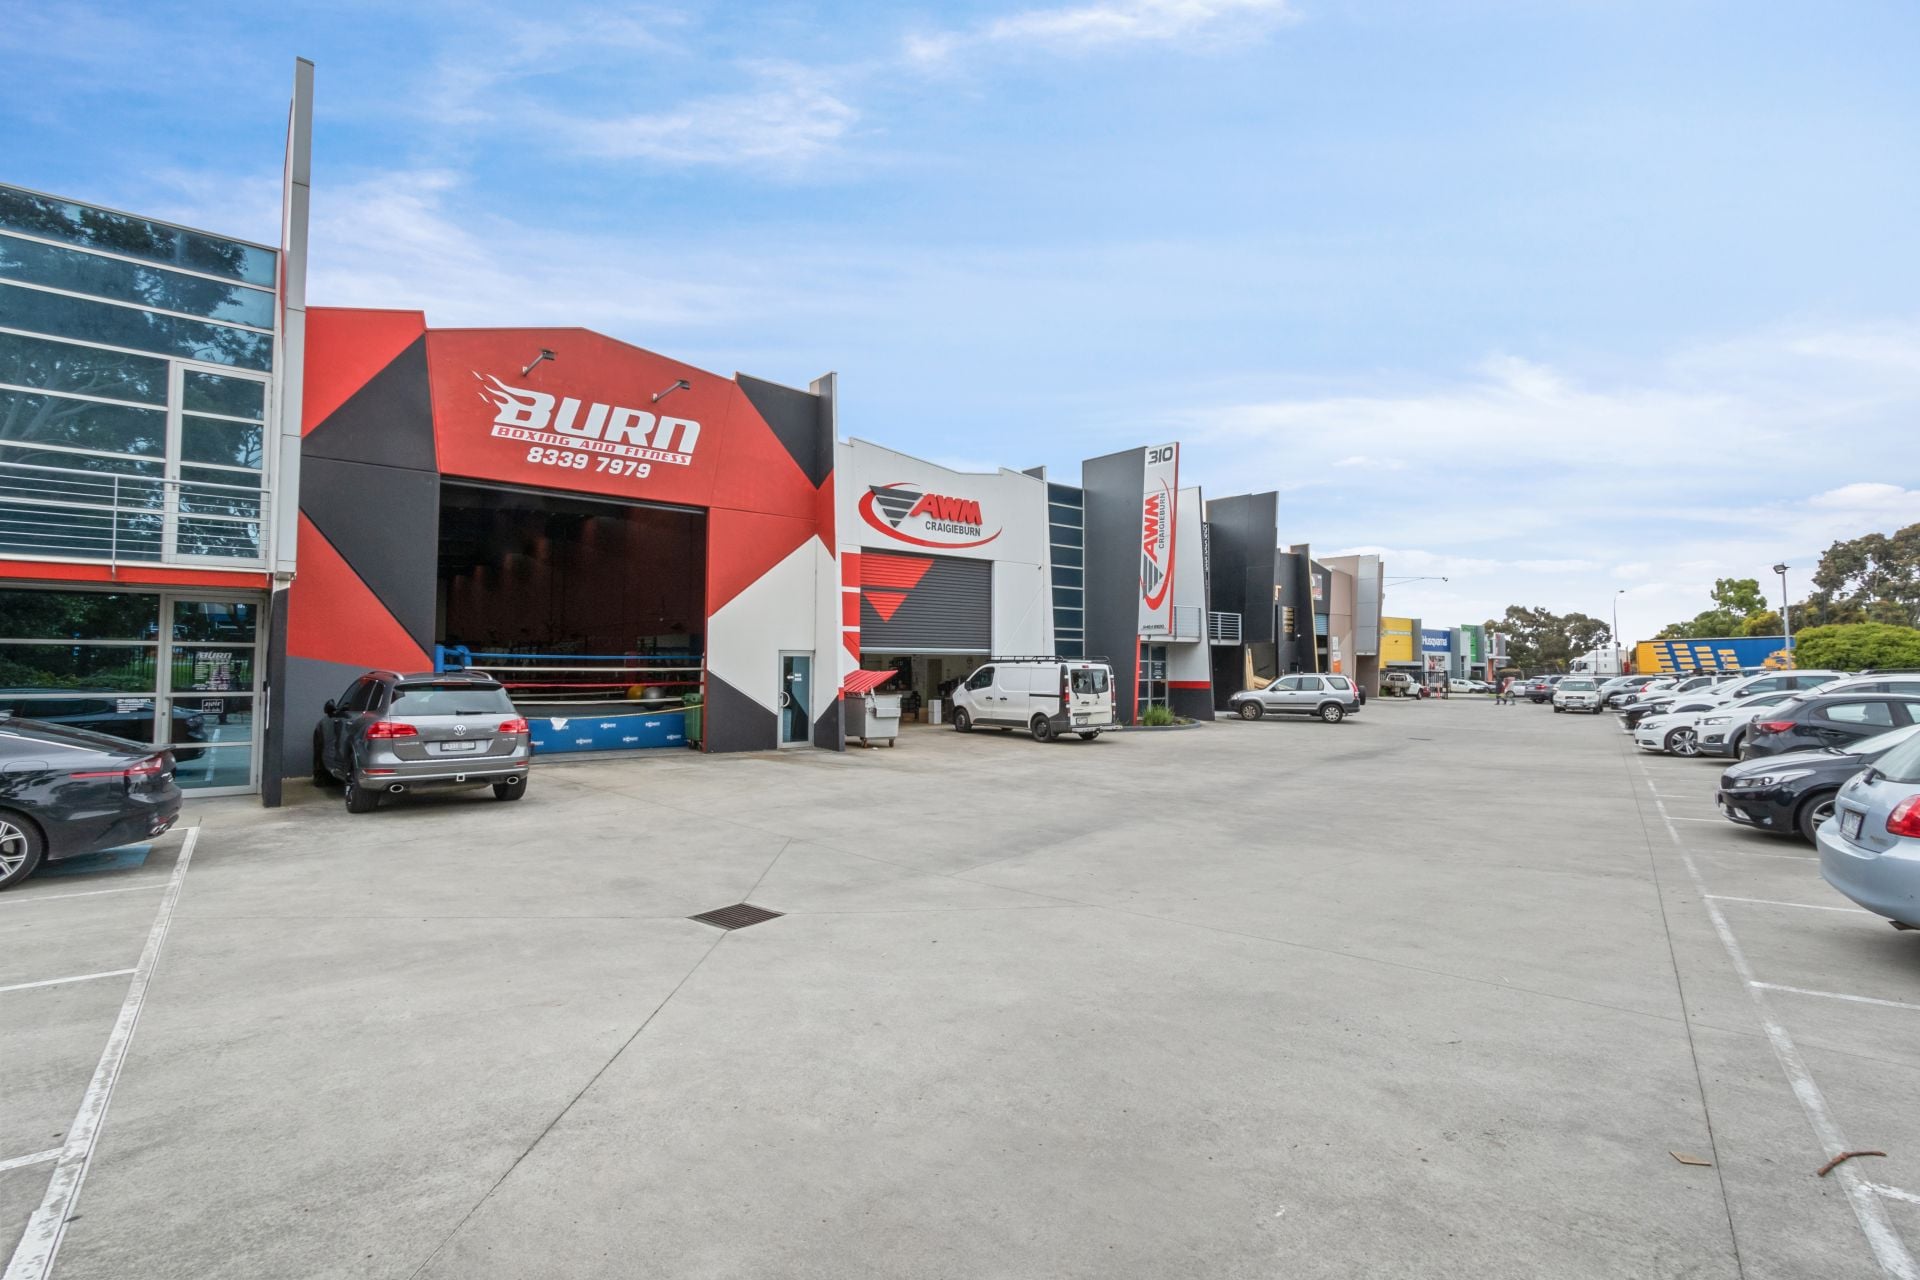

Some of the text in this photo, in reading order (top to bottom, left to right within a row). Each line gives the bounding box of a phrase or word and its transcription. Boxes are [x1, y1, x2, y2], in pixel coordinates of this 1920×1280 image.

[484, 374, 700, 454] BURN
[497, 426, 688, 464] BOXING AND FITNESS
[527, 446, 651, 479] 8339 7979
[1148, 446, 1174, 465] 310
[909, 493, 983, 526] AWM
[1158, 492, 1166, 549] CRAIGIEBURN
[925, 520, 981, 537] CRAIGIEBURN
[1143, 493, 1159, 565] AWM
